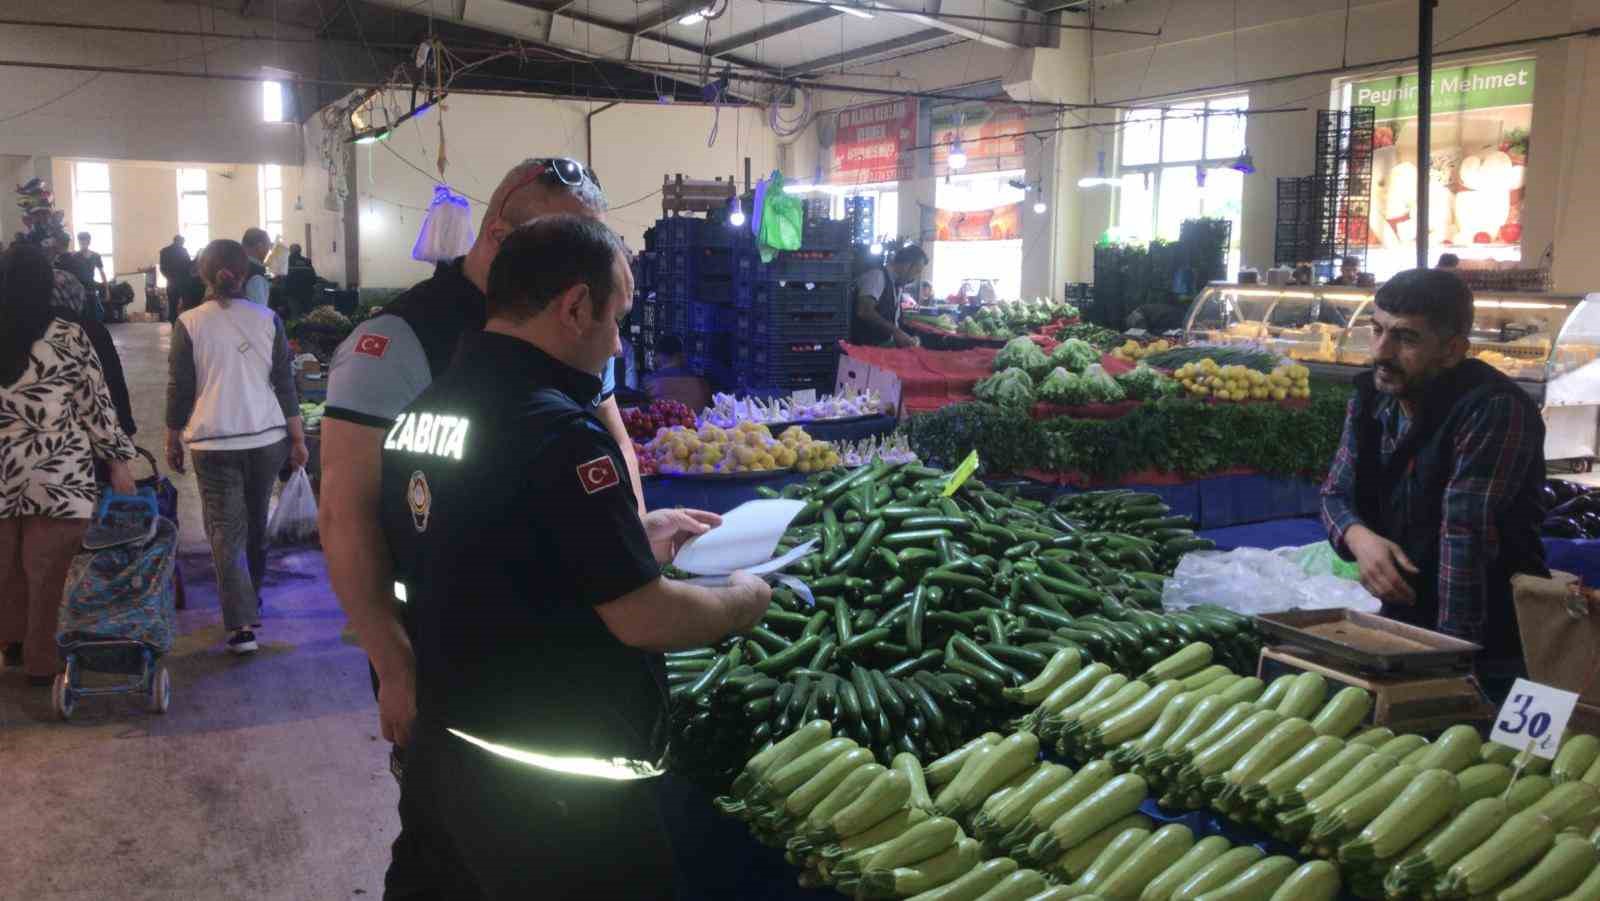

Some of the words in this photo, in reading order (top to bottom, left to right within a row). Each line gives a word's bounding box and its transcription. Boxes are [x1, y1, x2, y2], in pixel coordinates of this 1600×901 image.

[1358, 80, 1435, 106] Peyniri
[1440, 69, 1528, 94] Mehmet
[384, 412, 469, 460] ZABITA
[1498, 693, 1551, 738] 30
